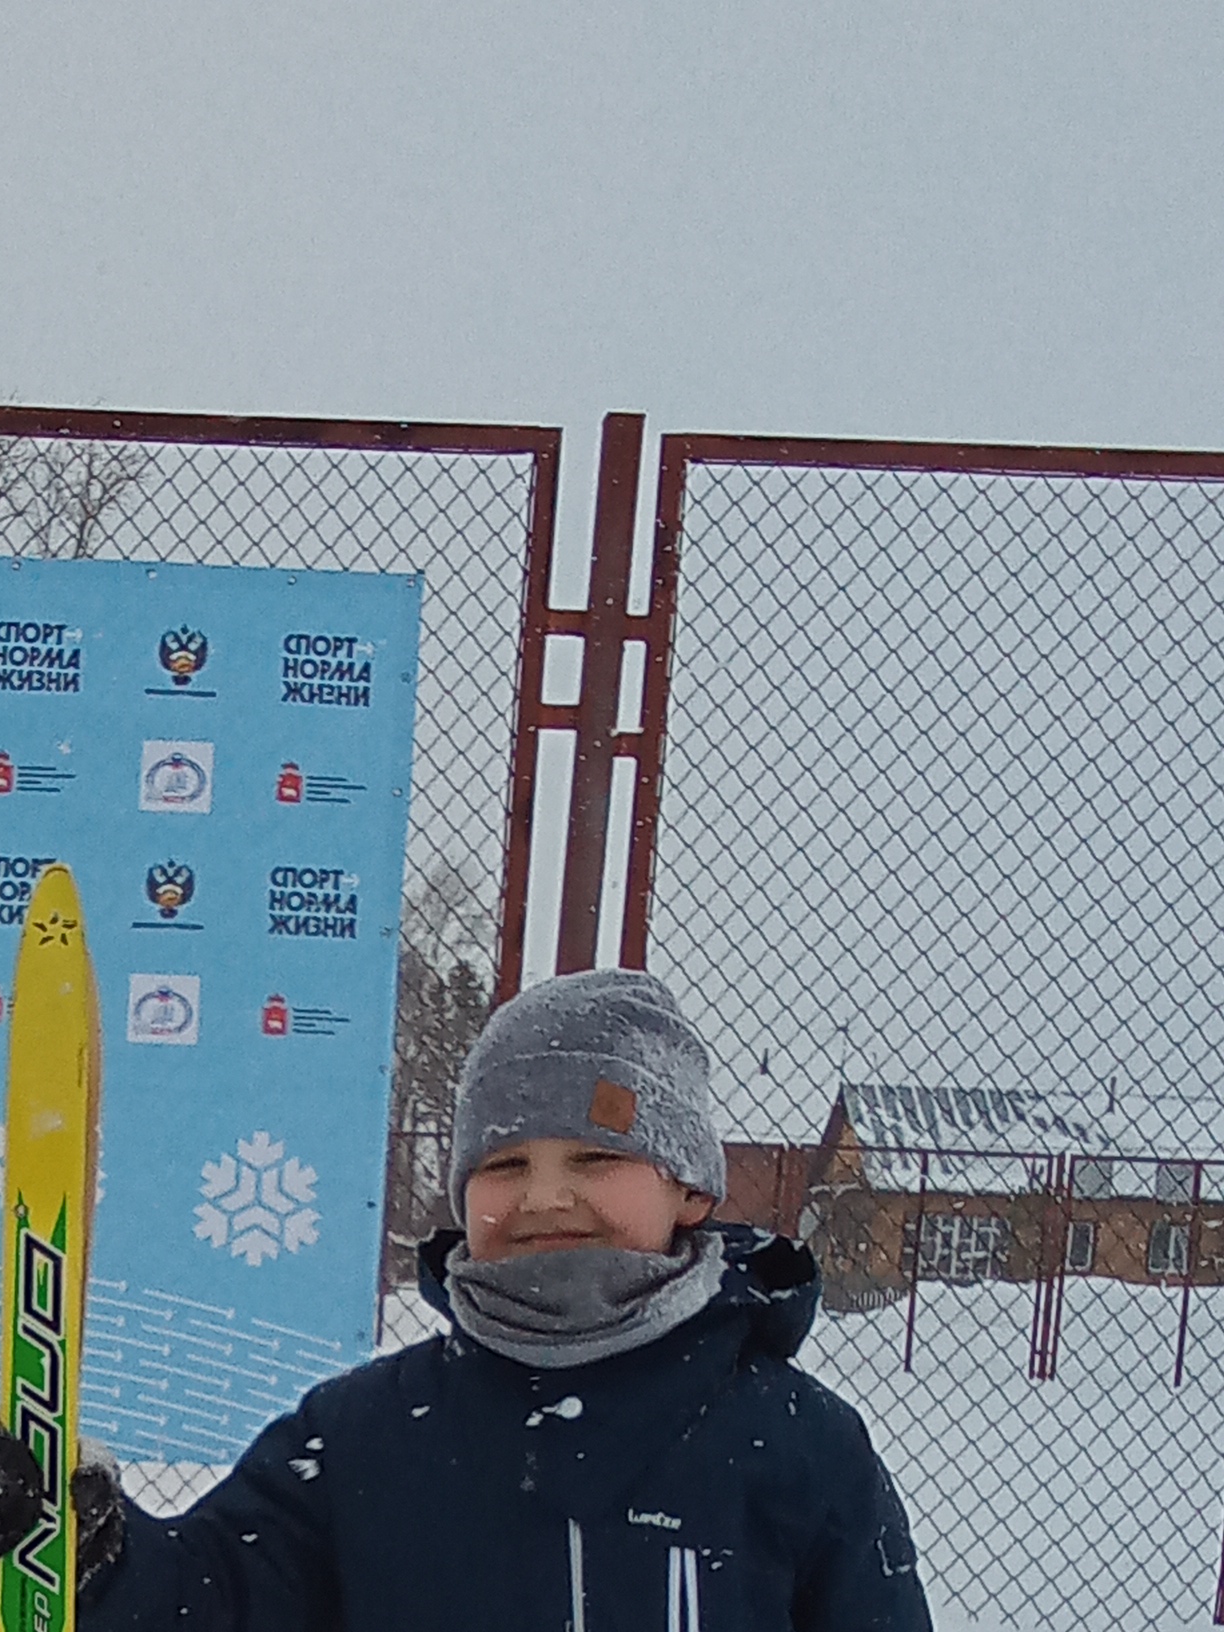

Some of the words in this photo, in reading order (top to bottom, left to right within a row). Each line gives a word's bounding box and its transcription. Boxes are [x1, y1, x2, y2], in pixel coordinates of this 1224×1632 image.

[283, 633, 358, 659] СПОРТ
[282, 656, 372, 684] НОРМА
[280, 680, 371, 708] ЖИЗНИ
[270, 865, 345, 891] СПОРТ
[268, 888, 358, 916] НОРМА
[267, 912, 357, 940] ЖИЗНИ
